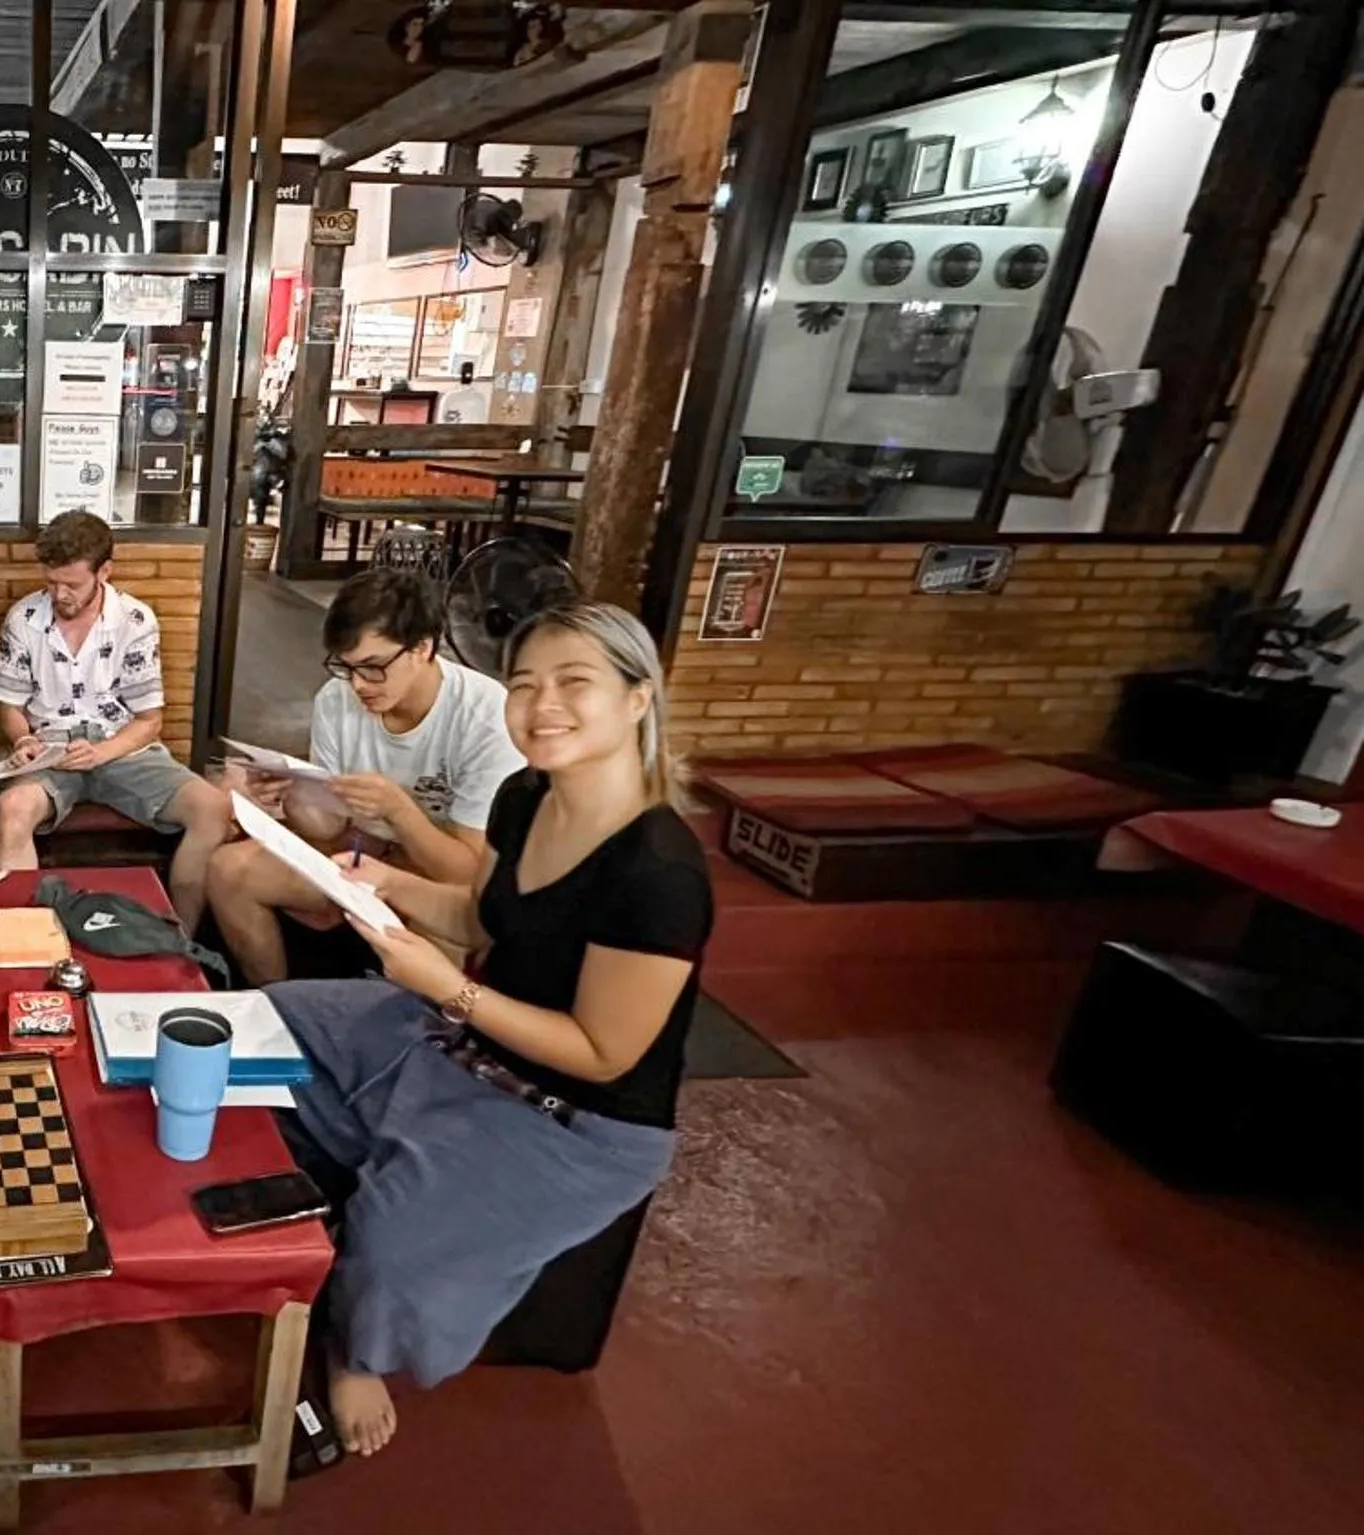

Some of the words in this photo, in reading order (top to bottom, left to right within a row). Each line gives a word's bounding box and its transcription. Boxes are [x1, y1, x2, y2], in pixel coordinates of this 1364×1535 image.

[276, 183, 301, 199] eet!
[68, 301, 93, 314] BAR
[737, 817, 812, 875] SLIDE
[19, 995, 65, 1013] UNO
[39, 1255, 67, 1275] ALL
